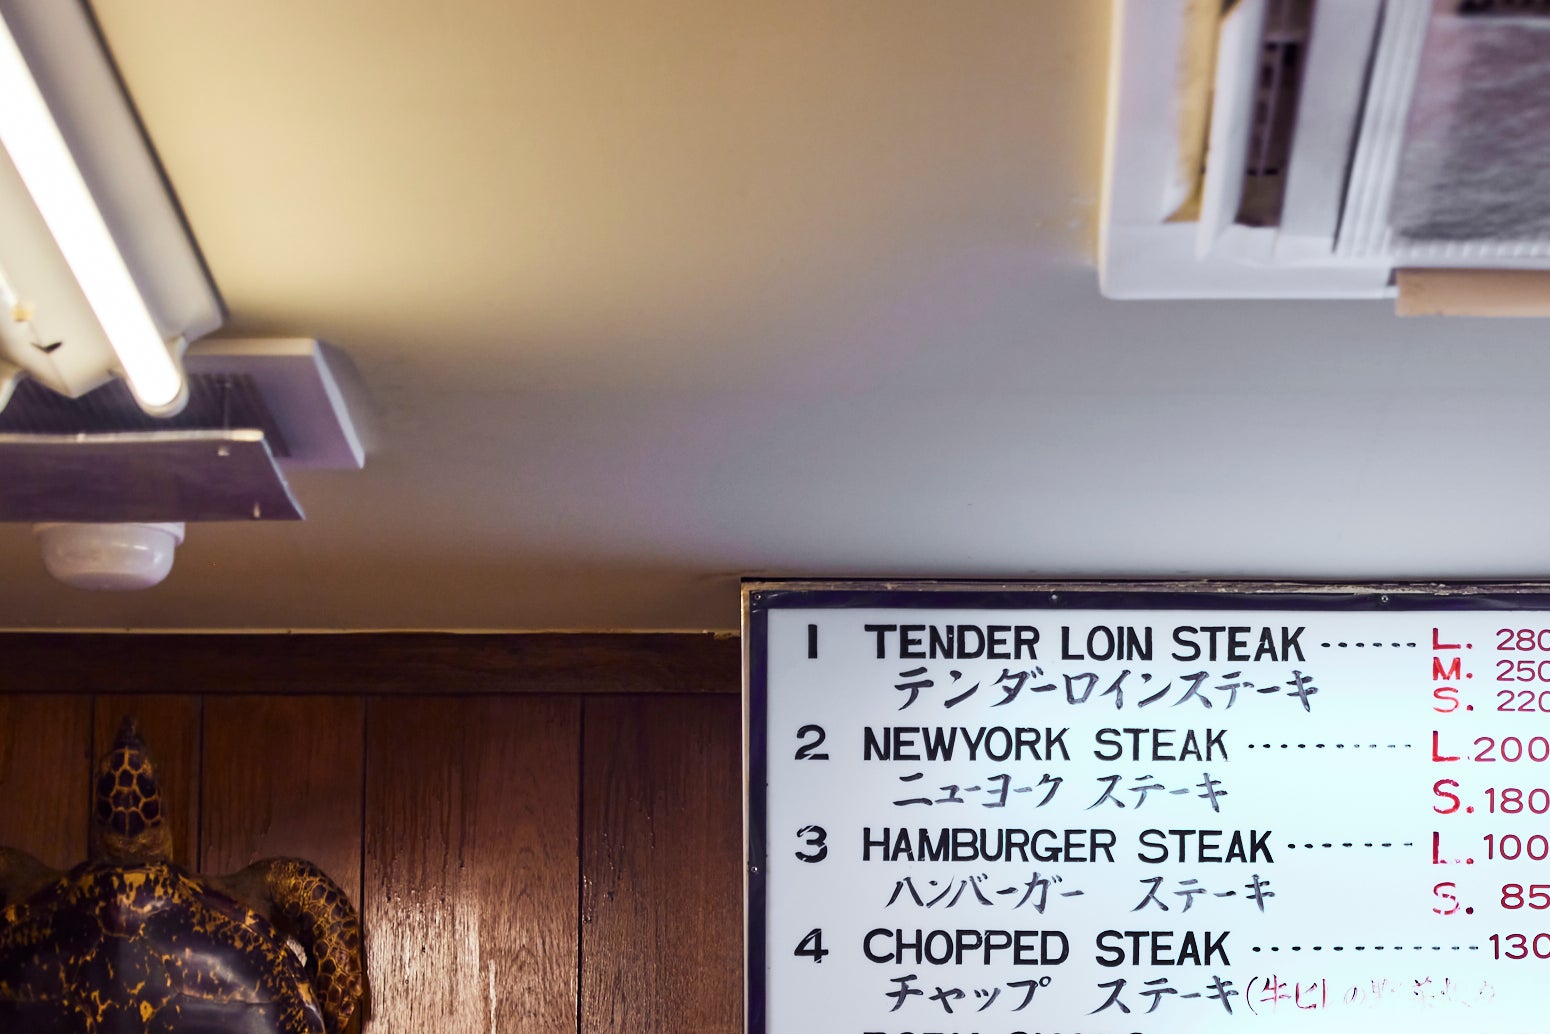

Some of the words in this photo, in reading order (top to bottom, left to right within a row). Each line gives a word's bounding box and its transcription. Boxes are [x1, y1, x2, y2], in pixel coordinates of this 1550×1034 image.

[807, 623, 818, 660] 1
[863, 623, 1041, 661] TENDER
[1060, 624, 1153, 662] LOIN
[1170, 625, 1307, 663] STEAK
[1432, 627, 1473, 651] L.
[1432, 656, 1474, 681] M.
[893, 665, 1319, 713] テンダーロインステーキ
[1432, 686, 1474, 714] S.
[794, 723, 830, 761] 2
[863, 725, 1071, 763] NEWYORK
[1092, 727, 1229, 762] STEAK
[891, 771, 1064, 809] ニューヨーク
[1086, 772, 1229, 814] ステーキ
[1432, 778, 1475, 815] S.
[794, 824, 828, 864] 3
[862, 826, 1117, 863] HAMBURGER
[1137, 828, 1275, 865] STEAK
[1432, 830, 1475, 865] L.
[884, 871, 1085, 914] ハンバーガー
[1129, 873, 1276, 914] ステーキ
[1432, 881, 1475, 916] S.
[793, 927, 830, 964] 4
[862, 927, 1070, 966] CHOPPED
[1095, 929, 1232, 968] STEAK
[884, 973, 1053, 1015] チャップ
[1087, 974, 1240, 1016] ステーキ
